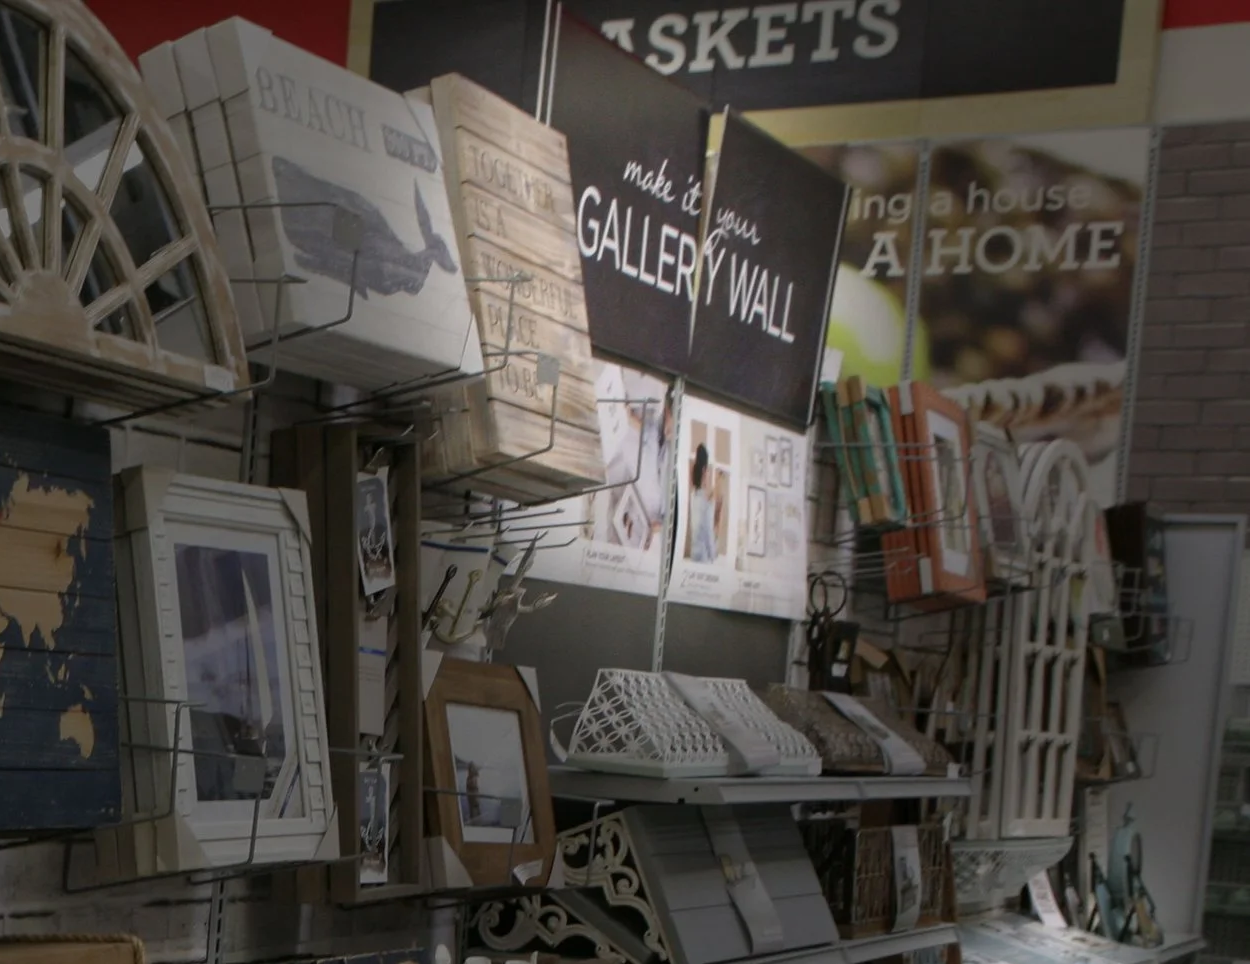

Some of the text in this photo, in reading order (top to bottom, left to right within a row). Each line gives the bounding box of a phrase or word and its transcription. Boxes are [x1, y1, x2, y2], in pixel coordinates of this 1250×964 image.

[601, 0, 901, 75] SKETS
[255, 65, 372, 154] BEACH
[623, 158, 762, 254] make it your
[852, 180, 1094, 224] ing a house
[577, 185, 796, 344] GALLERY WALL
[859, 221, 1125, 278] A HOME
[480, 251, 578, 321] WONDERFUL
[487, 303, 540, 351] PLACE
